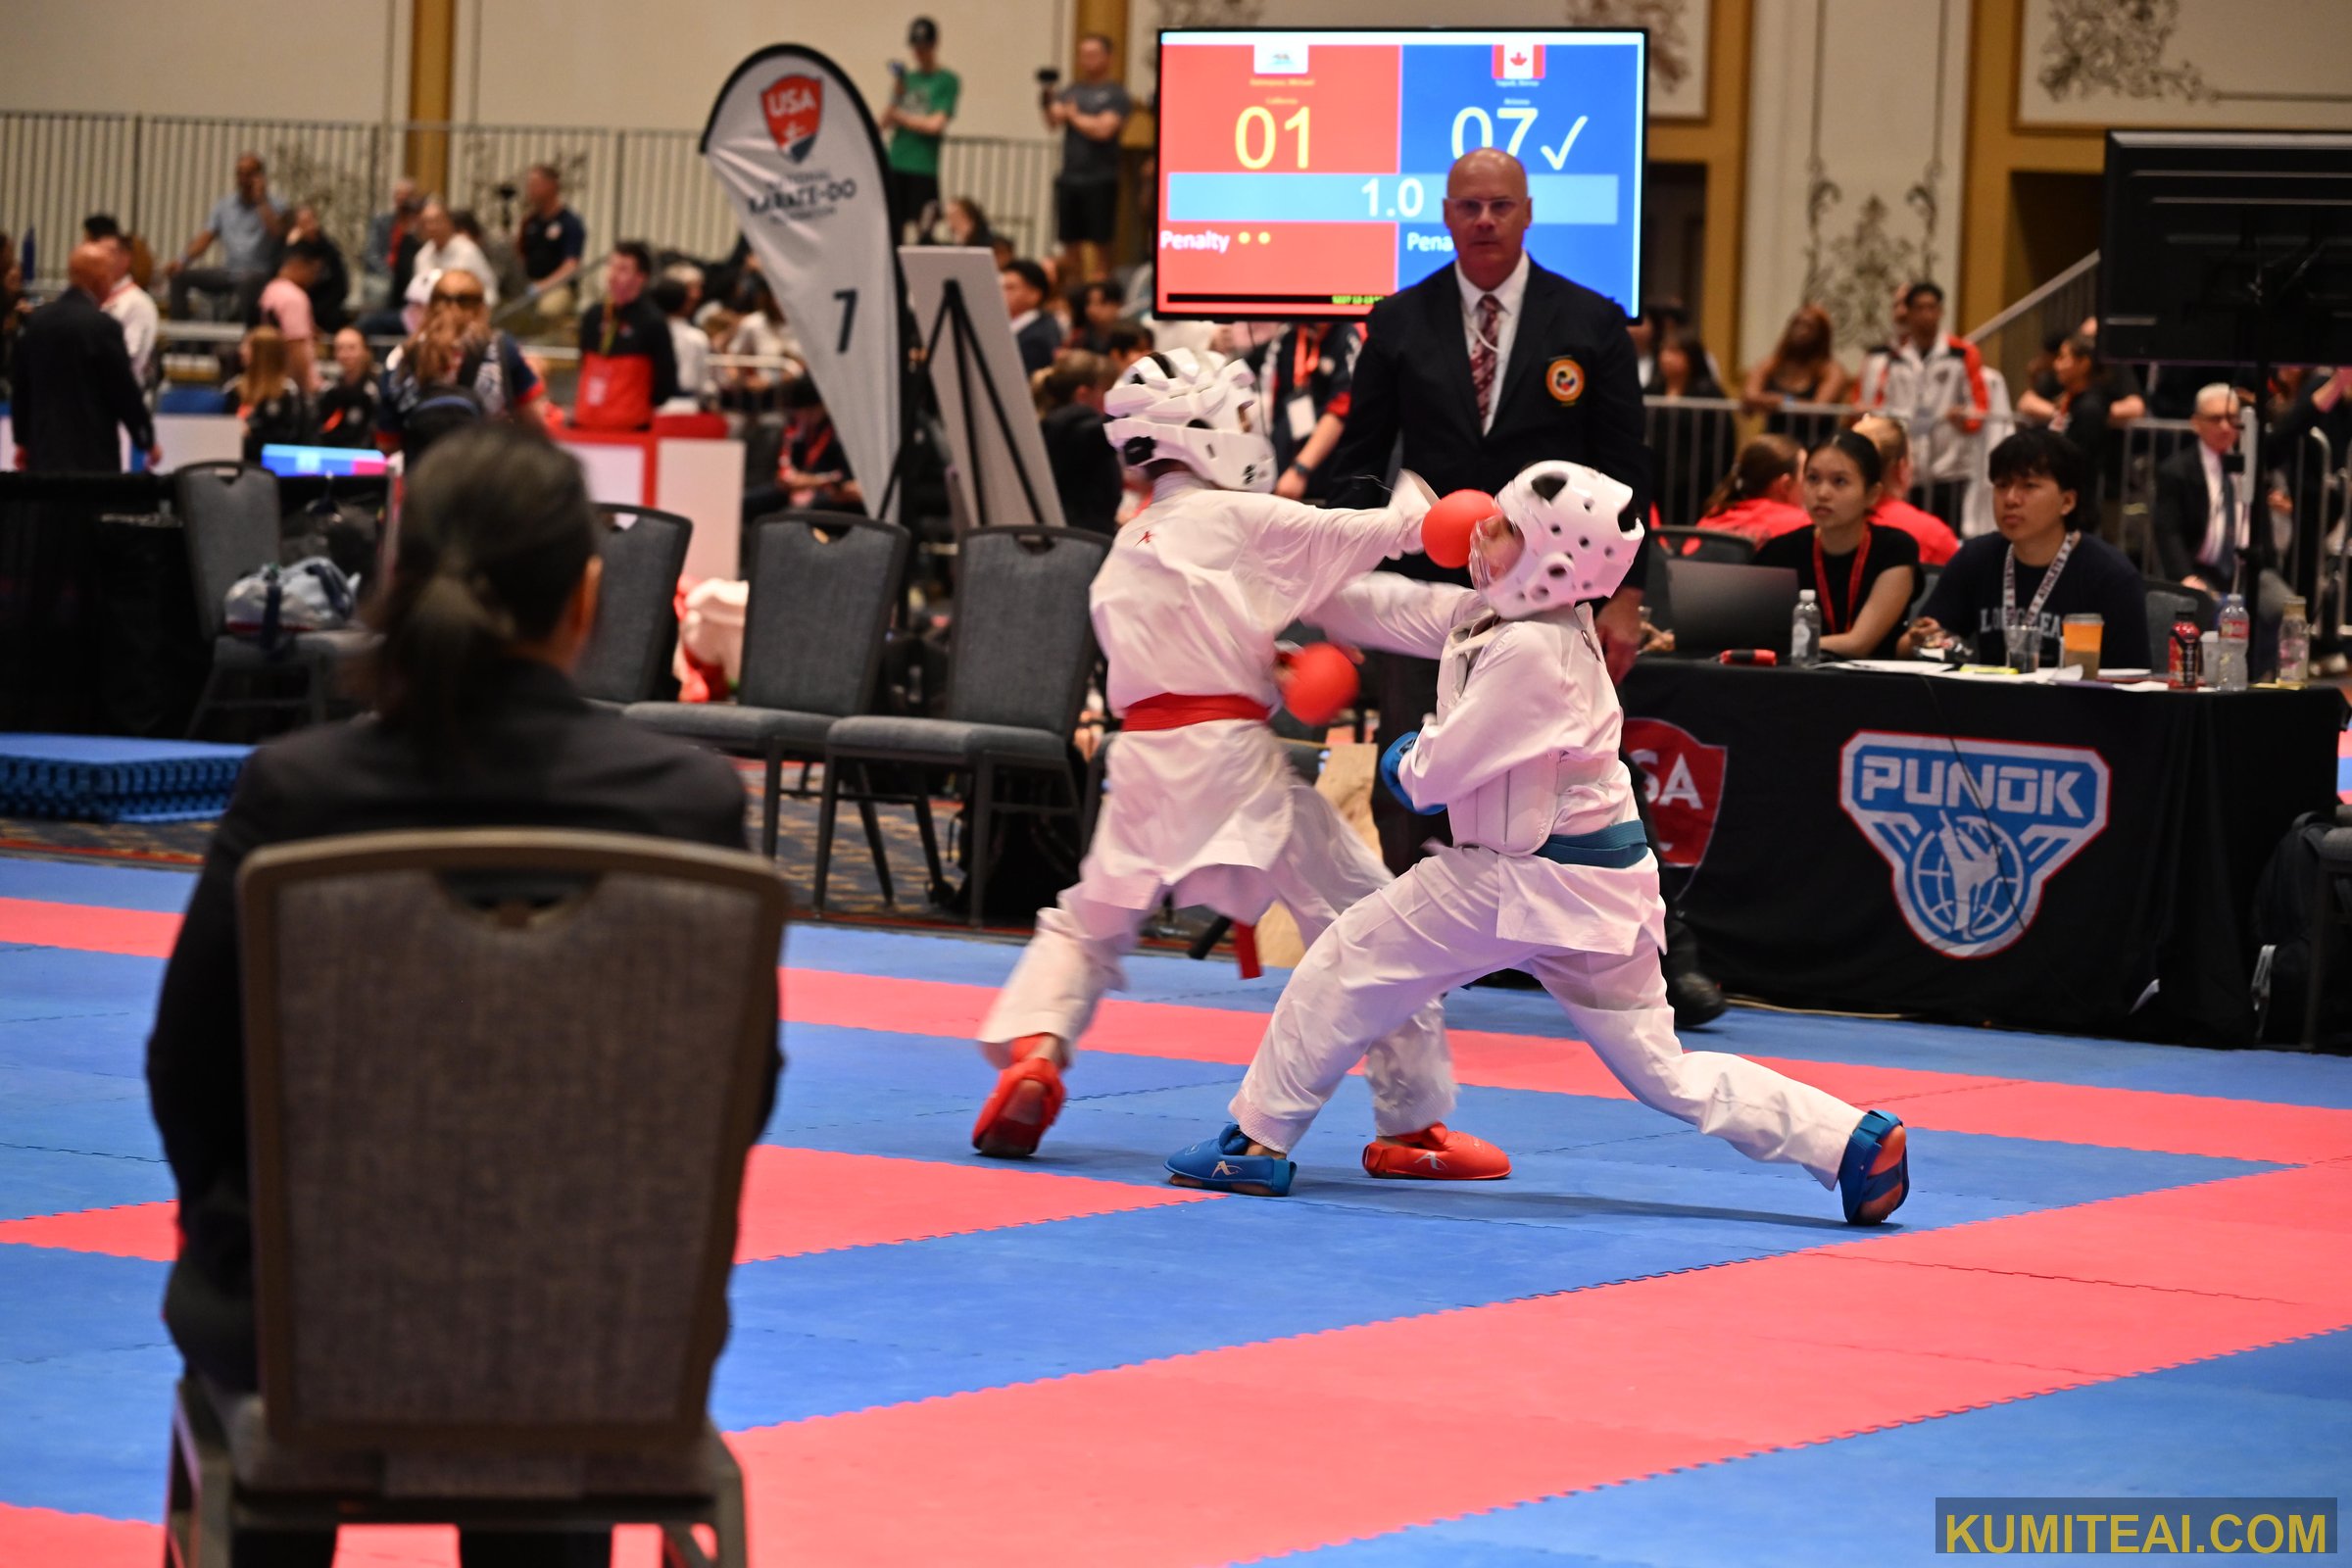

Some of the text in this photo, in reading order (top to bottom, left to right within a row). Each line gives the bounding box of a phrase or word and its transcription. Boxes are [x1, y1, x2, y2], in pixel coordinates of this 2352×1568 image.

[765, 87, 817, 117] USA
[1235, 107, 1310, 169] 01
[1451, 108, 1539, 160] 07
[1360, 178, 1425, 218] 1.0
[1160, 230, 1230, 254] Penalty
[1407, 232, 1454, 252] Pena
[832, 288, 858, 355] 7
[1631, 748, 1704, 810] SA
[1862, 756, 2084, 818] PUNOK
